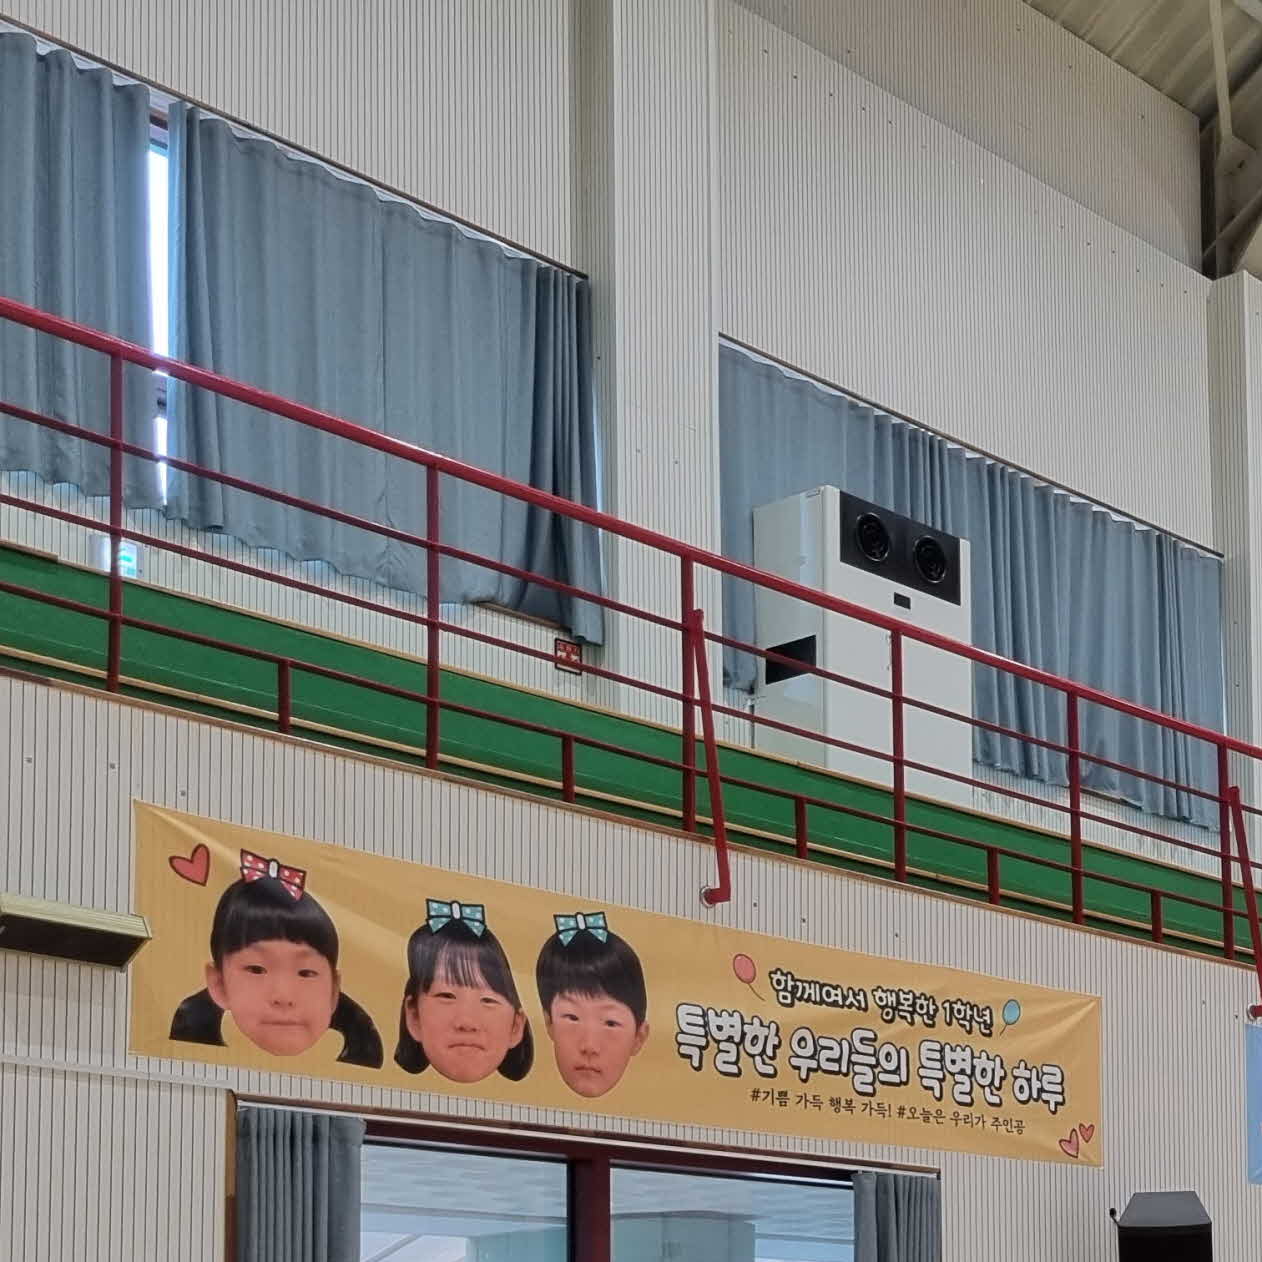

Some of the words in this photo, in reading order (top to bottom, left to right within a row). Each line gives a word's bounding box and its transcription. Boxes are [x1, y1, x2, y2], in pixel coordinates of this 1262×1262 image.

[769, 968, 868, 1012] 함께여서
[872, 986, 937, 1027] 행복한
[943, 1002, 993, 1037] 1학년
[676, 1002, 780, 1077] 특별한
[788, 1026, 909, 1099] 우리들의
[918, 1039, 1005, 1108] 특별한
[1012, 1061, 1065, 1113] 하루
[750, 1087, 790, 1106] #기쁨
[796, 1093, 823, 1110] 가득
[830, 1096, 856, 1114] 행복
[861, 1100, 892, 1119] 가득!
[897, 1105, 945, 1125] #오늘은
[950, 1110, 986, 1130] 우리가
[991, 1116, 1025, 1135] 주인공
